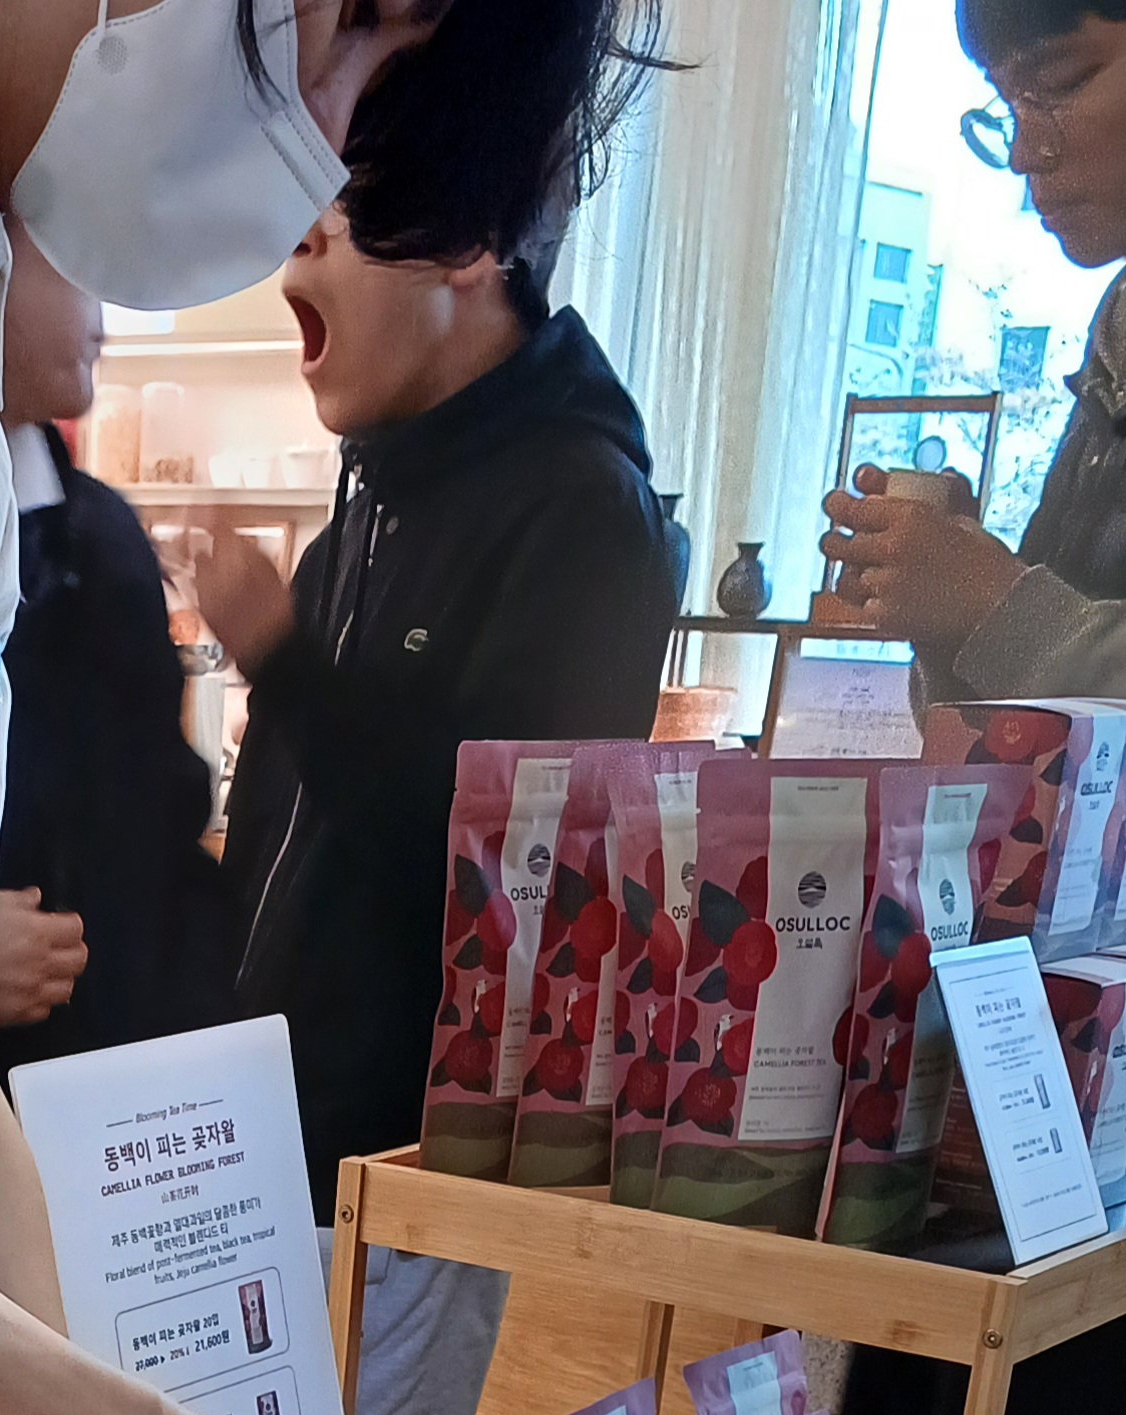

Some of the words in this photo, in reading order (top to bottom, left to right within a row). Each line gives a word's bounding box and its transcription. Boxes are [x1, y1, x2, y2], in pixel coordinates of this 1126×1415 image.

[775, 916, 851, 933] OSULLOC
[930, 921, 969, 942] OSULLOC
[135, 1109, 167, 1124] Blooming
[104, 1138, 152, 1172] 동백이
[156, 1132, 186, 1158] 피는
[192, 1118, 236, 1151] 곶자왈
[101, 1178, 142, 1197] CAMELLIA
[145, 1170, 175, 1186] FLOWER
[177, 1159, 215, 1178] BLOOMING
[218, 1151, 245, 1168] FOREST
[111, 1232, 129, 1248] 제주
[105, 1268, 125, 1283] Floral
[126, 1262, 146, 1277] blend
[147, 1259, 156, 1272] of
[156, 1245, 208, 1271] post-fermented
[222, 1236, 240, 1250] black
[132, 1332, 157, 1352] 동백이
[159, 1328, 175, 1343] 피는
[203, 1313, 220, 1329] 20입
[195, 1329, 230, 1353] 21,600원
